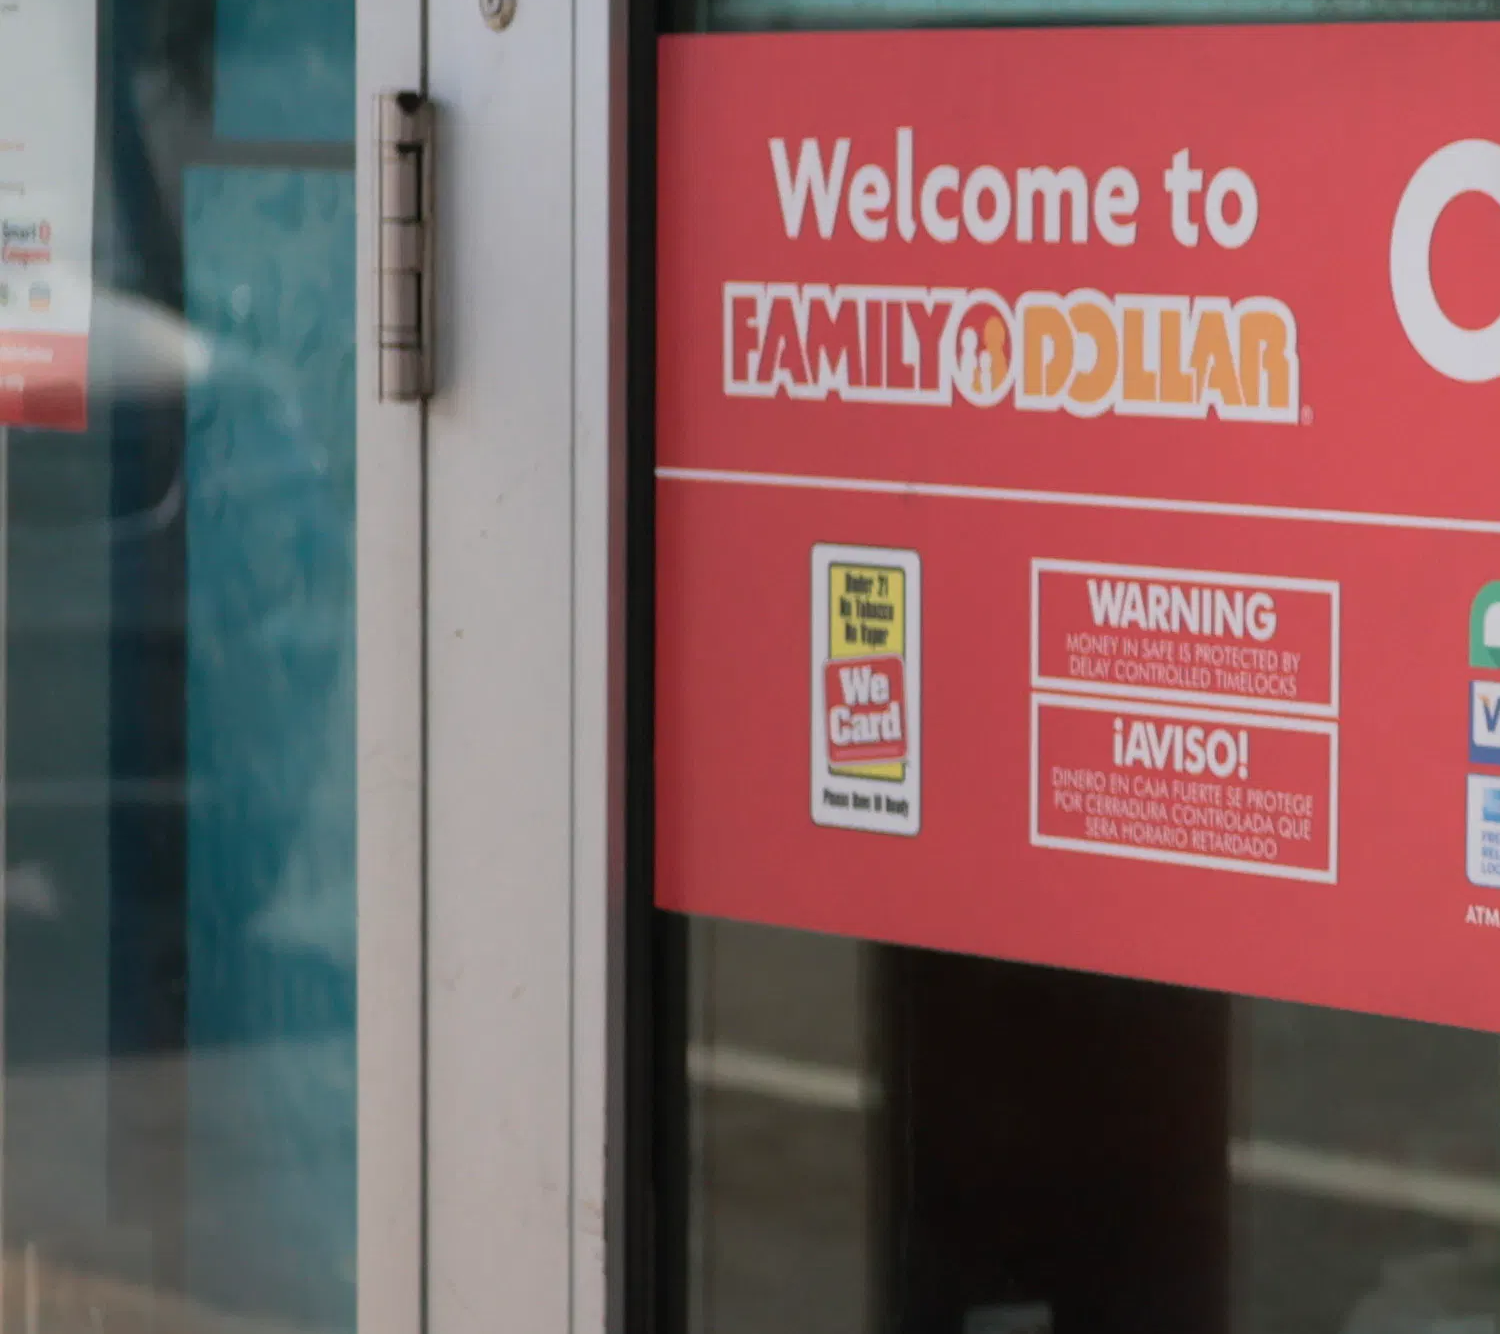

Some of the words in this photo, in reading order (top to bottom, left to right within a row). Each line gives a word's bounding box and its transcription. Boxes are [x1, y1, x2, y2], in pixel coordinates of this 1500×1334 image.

[769, 126, 1140, 247] Welcome
[1164, 148, 1258, 249] to
[723, 282, 965, 406] FAMILY
[877, 574, 889, 598] 21
[1087, 578, 1278, 642] WARNING
[1066, 633, 1120, 656] MONEY
[1123, 636, 1139, 658] IN
[1142, 638, 1174, 661] SAFE
[1179, 641, 1191, 662] IS
[1195, 642, 1278, 671] PROTECTED
[1282, 649, 1302, 673] BY
[1070, 654, 1111, 680] DELAY
[1115, 658, 1211, 690] CONTROLLED
[1216, 667, 1298, 699] TIMELOCKS
[838, 666, 891, 708] We
[829, 701, 902, 747] Card
[1113, 717, 1250, 781] ¡AVISO!
[1052, 766, 1106, 794] DINERO
[1110, 771, 1129, 795] EN
[1133, 774, 1170, 801] CAJA
[1172, 777, 1223, 806] FUERTE
[1227, 783, 1243, 808] SE
[1247, 785, 1314, 818] PROTEGE
[1054, 789, 1082, 815] POR
[1086, 792, 1169, 823] CERRADURA
[1172, 801, 1275, 836] CONTROLADA
[1279, 813, 1312, 842] QUE
[1122, 820, 1189, 849] HORARIO
[1192, 830, 1278, 860] RETARDADO
